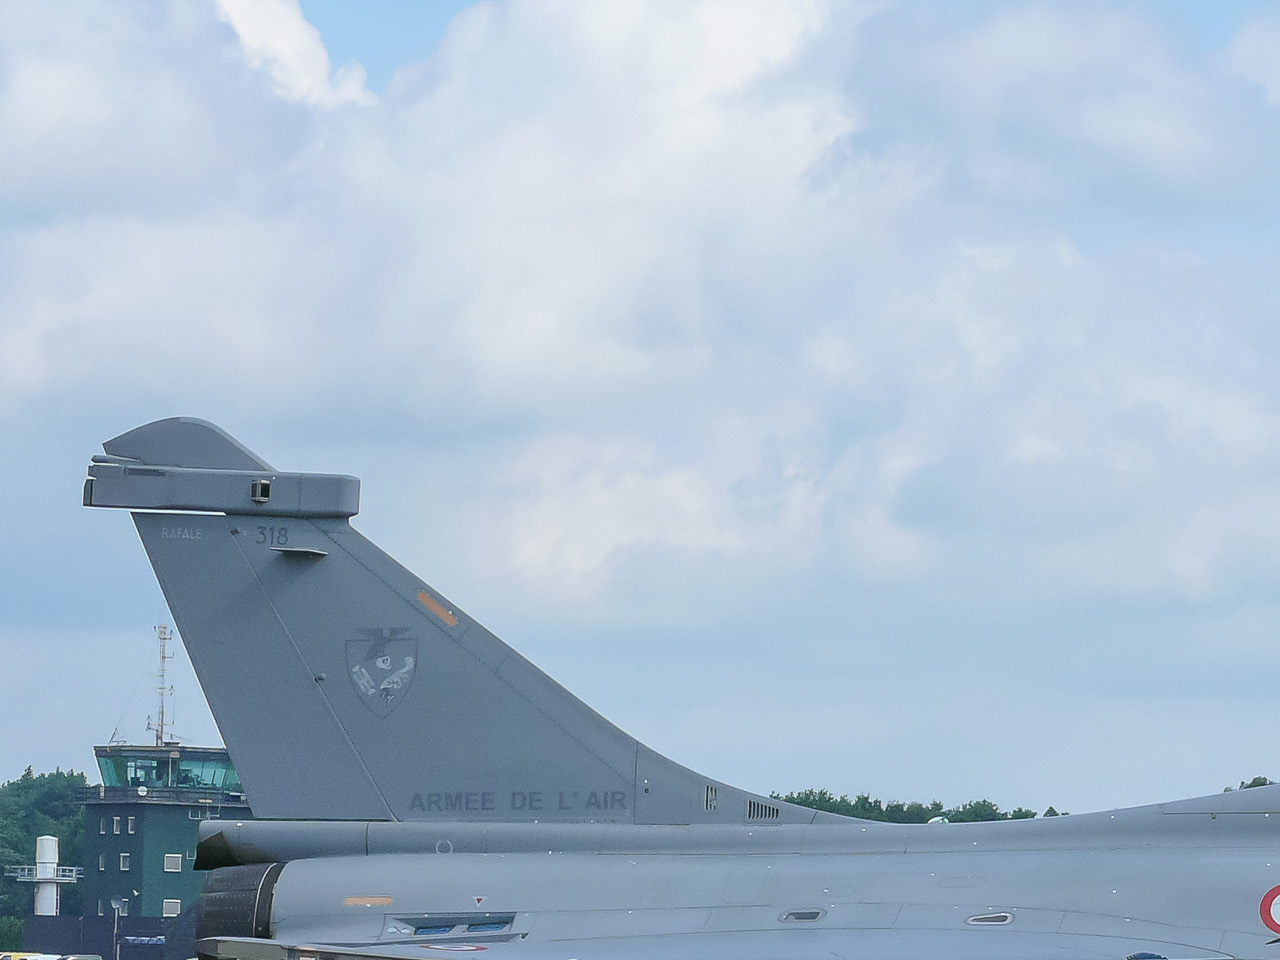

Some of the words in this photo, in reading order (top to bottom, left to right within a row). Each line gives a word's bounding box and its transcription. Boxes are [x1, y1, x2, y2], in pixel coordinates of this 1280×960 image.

[161, 527, 202, 540] RAFALE
[255, 525, 289, 545] 318
[408, 791, 495, 811] ARMEE
[511, 791, 543, 811] DE
